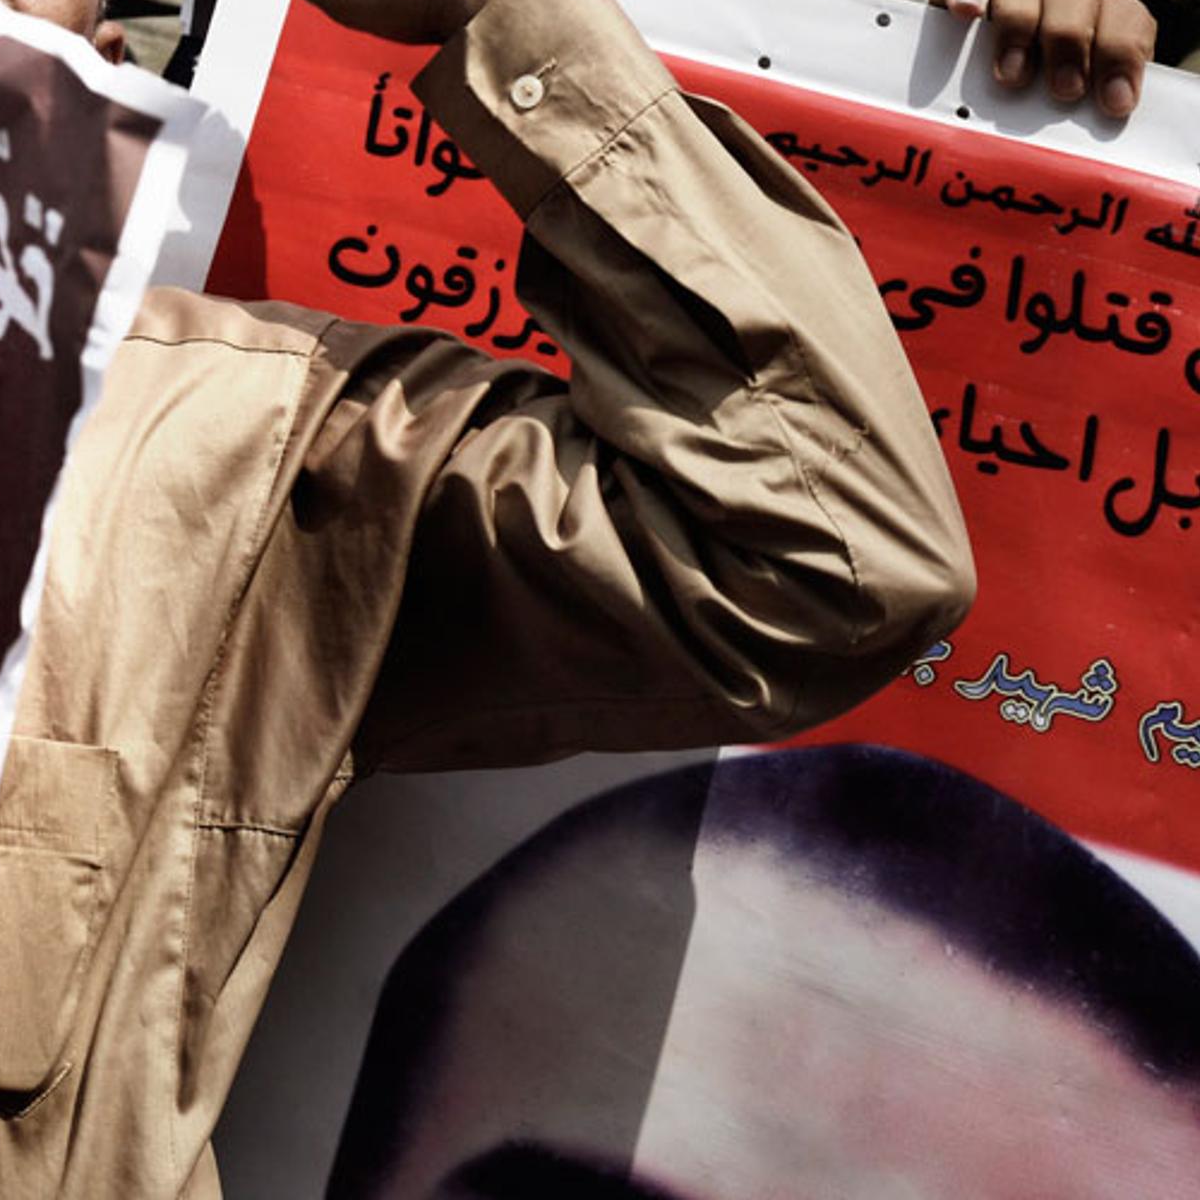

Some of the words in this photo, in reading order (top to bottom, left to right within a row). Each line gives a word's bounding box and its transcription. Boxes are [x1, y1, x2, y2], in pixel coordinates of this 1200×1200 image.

[765, 131, 932, 187] الرحيم
[938, 171, 1129, 235] الرحمن
[1005, 255, 1174, 356] قتلوا
[954, 654, 1117, 732] شهيد
